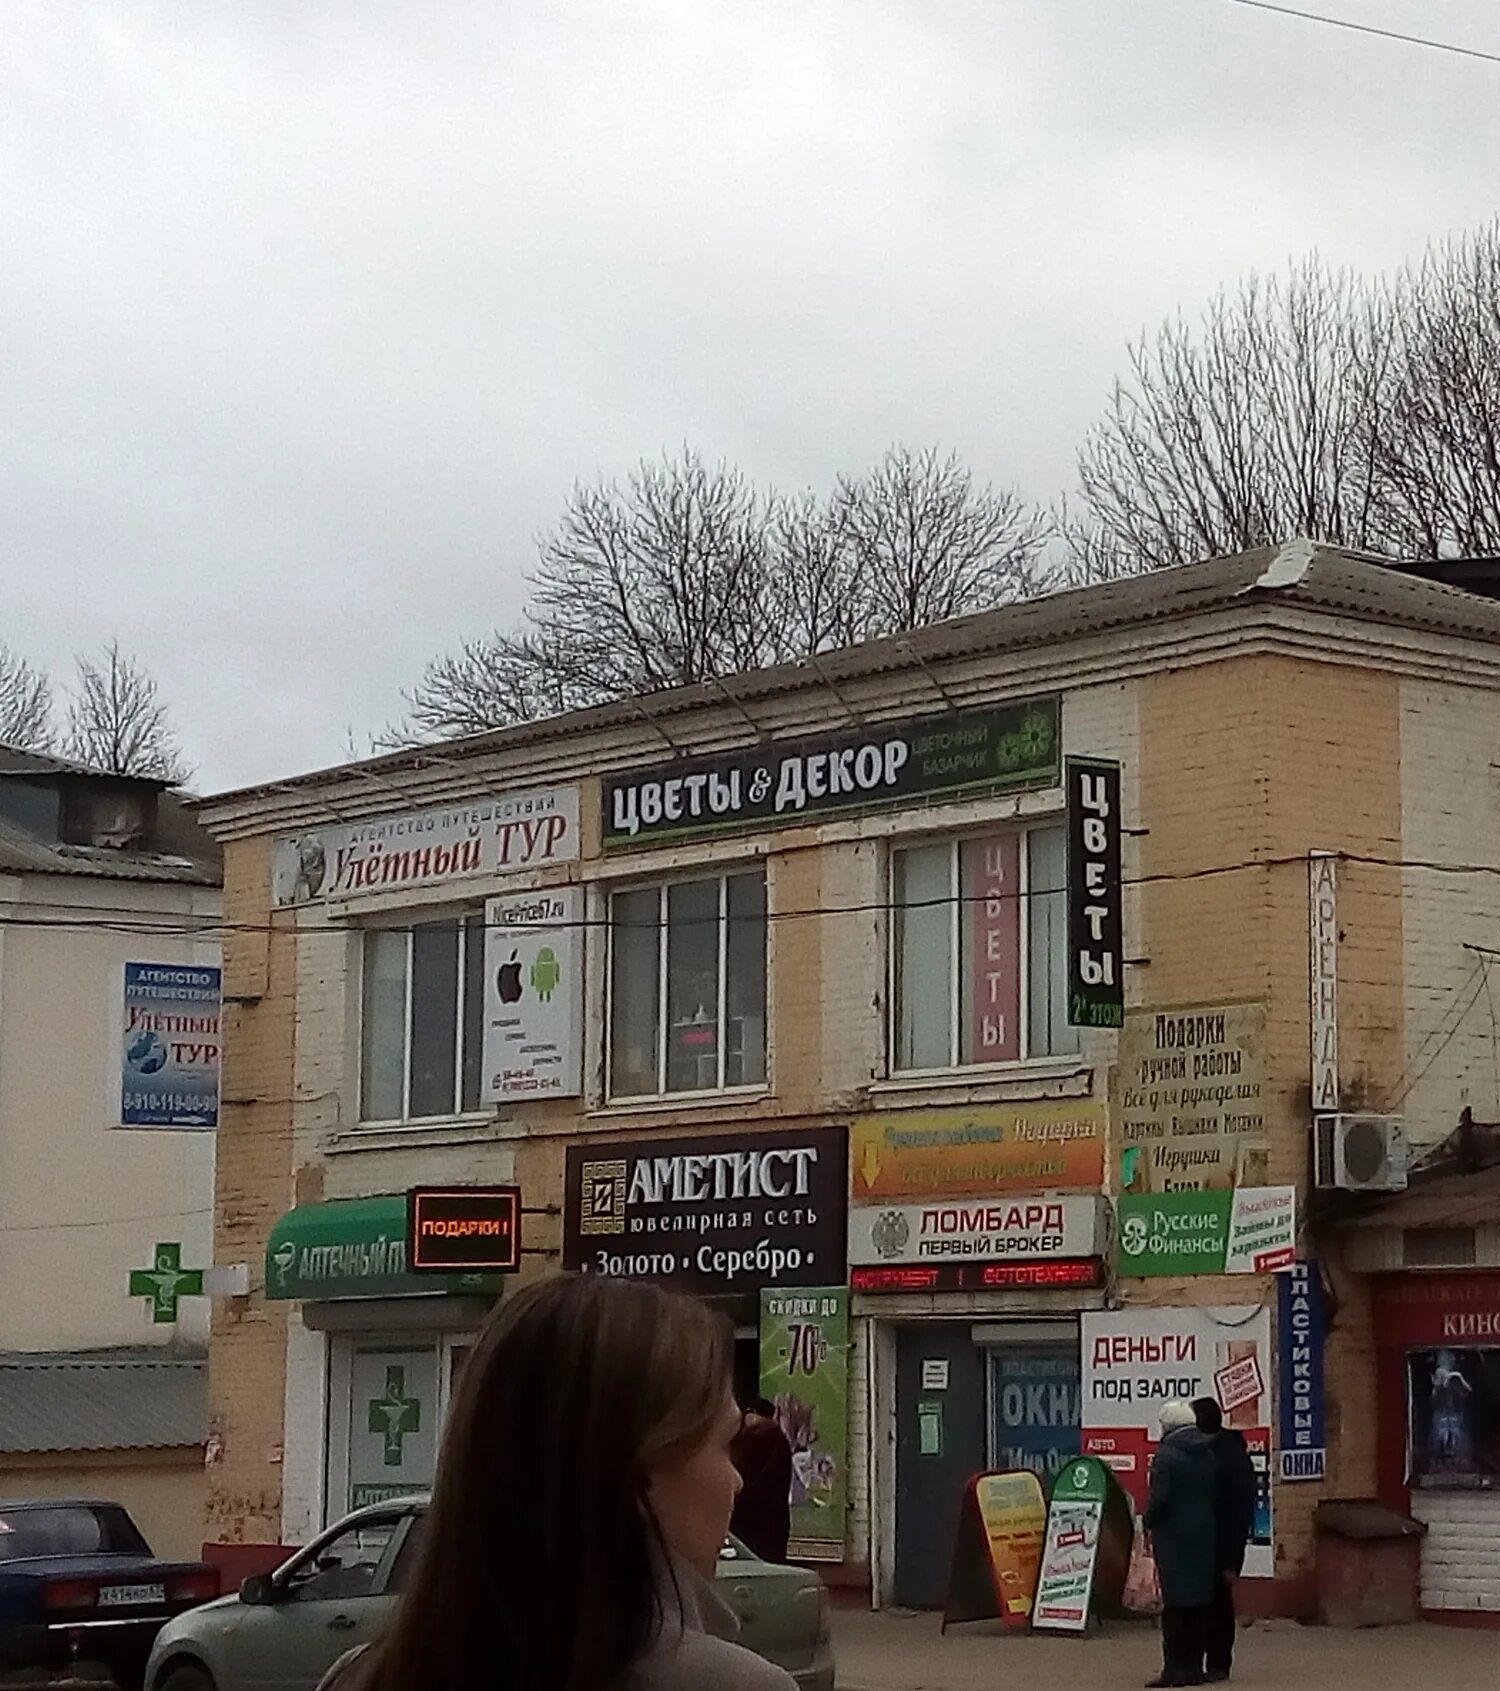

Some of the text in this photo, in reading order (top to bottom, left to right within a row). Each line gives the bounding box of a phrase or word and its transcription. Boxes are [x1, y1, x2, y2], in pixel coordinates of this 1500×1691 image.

[613, 740, 908, 836] ЦВЕТЫ & ДЕКОР
[495, 815, 567, 866] ТУР
[1080, 774, 1114, 985] ЦВЕТЫ
[1155, 1014, 1225, 1048] Подарки
[171, 1043, 217, 1063] ТУР
[1141, 1049, 1241, 1084] ручной работы
[1153, 1145, 1220, 1172] Игрушки
[627, 1147, 818, 1205] АМЕТИСТ
[631, 1207, 817, 1235] ювелирная сеть
[921, 1204, 1064, 1235] ЛОМБАРД
[1154, 1210, 1218, 1236] Русские
[299, 1234, 386, 1280] АПТЕЧНЫЙ
[596, 1238, 800, 1279] Золото Серебро
[919, 1236, 1063, 1256] ПЕРВЫЙ БРОКЕР
[1149, 1234, 1223, 1254] Финансы
[821, 1299, 837, 1316] ДО
[1093, 1335, 1196, 1368] ДЕНЬГИ
[1093, 1380, 1132, 1402] ПОД
[1138, 1379, 1201, 1398] ЗАЛОГ
